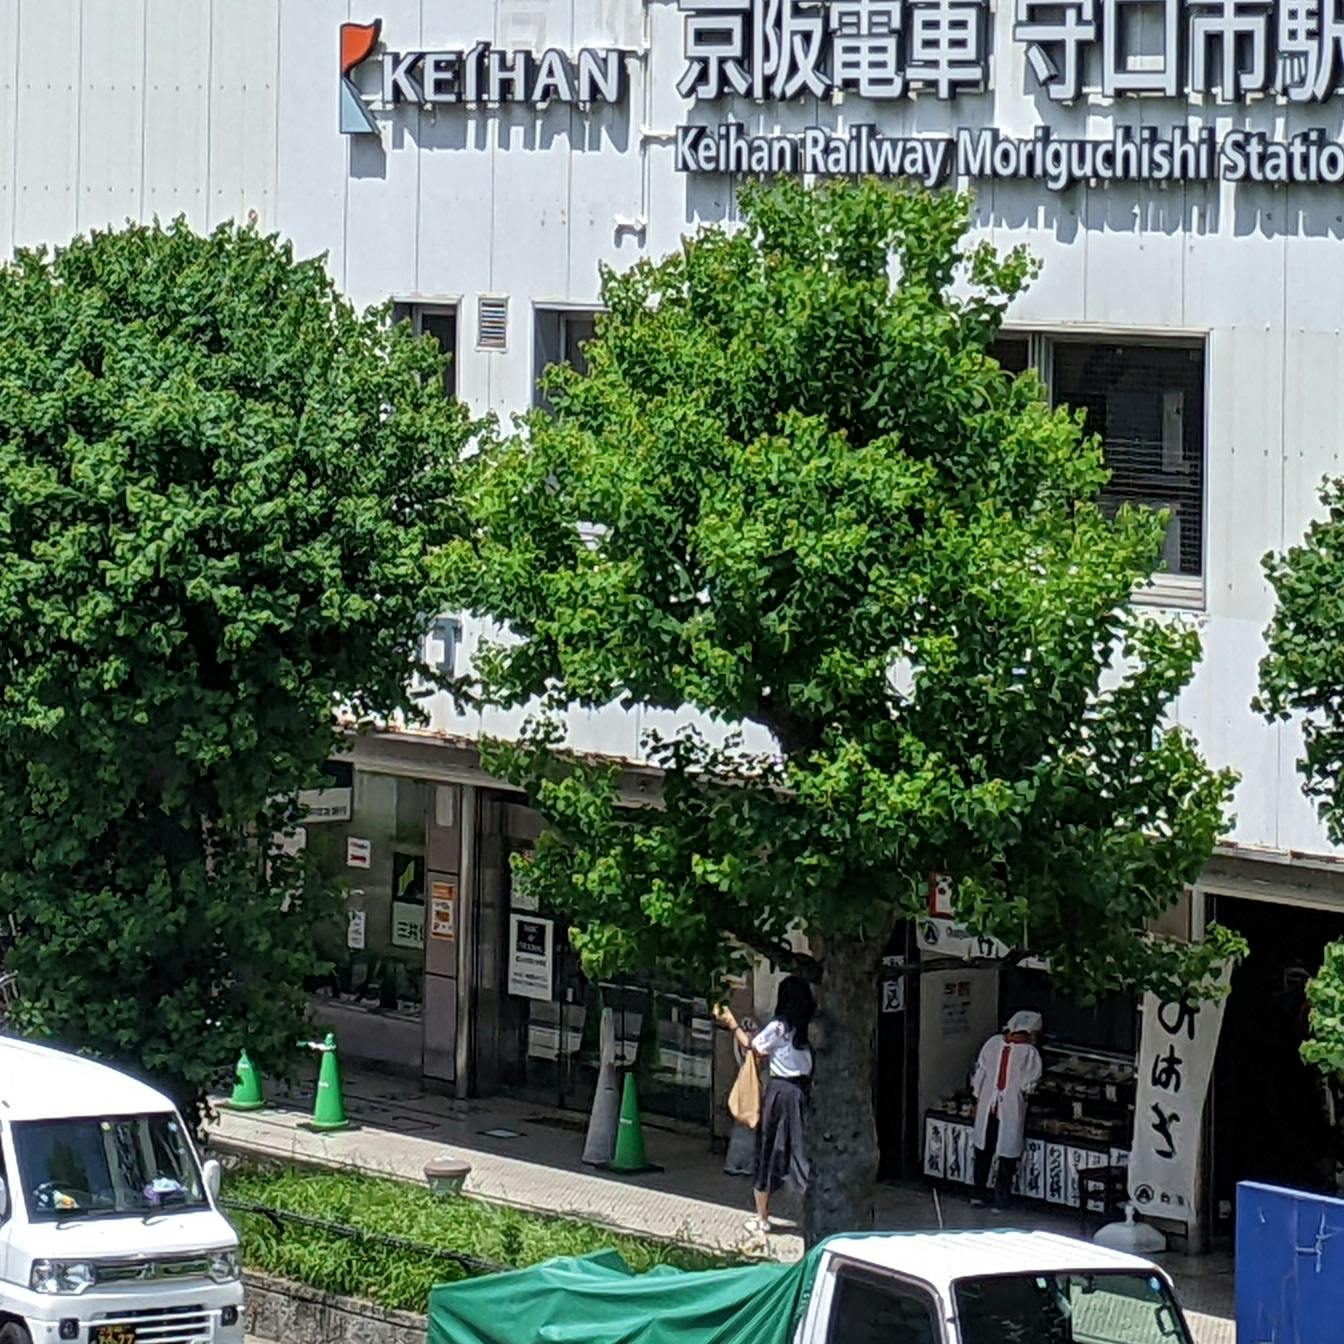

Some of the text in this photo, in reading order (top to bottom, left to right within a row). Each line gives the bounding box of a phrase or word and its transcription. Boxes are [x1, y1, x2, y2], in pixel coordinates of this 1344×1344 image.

[382, 41, 624, 104] KEIHAN
[674, 122, 798, 173] Keihan
[803, 122, 952, 186] Railway
[957, 125, 1215, 191] Moriguchishi
